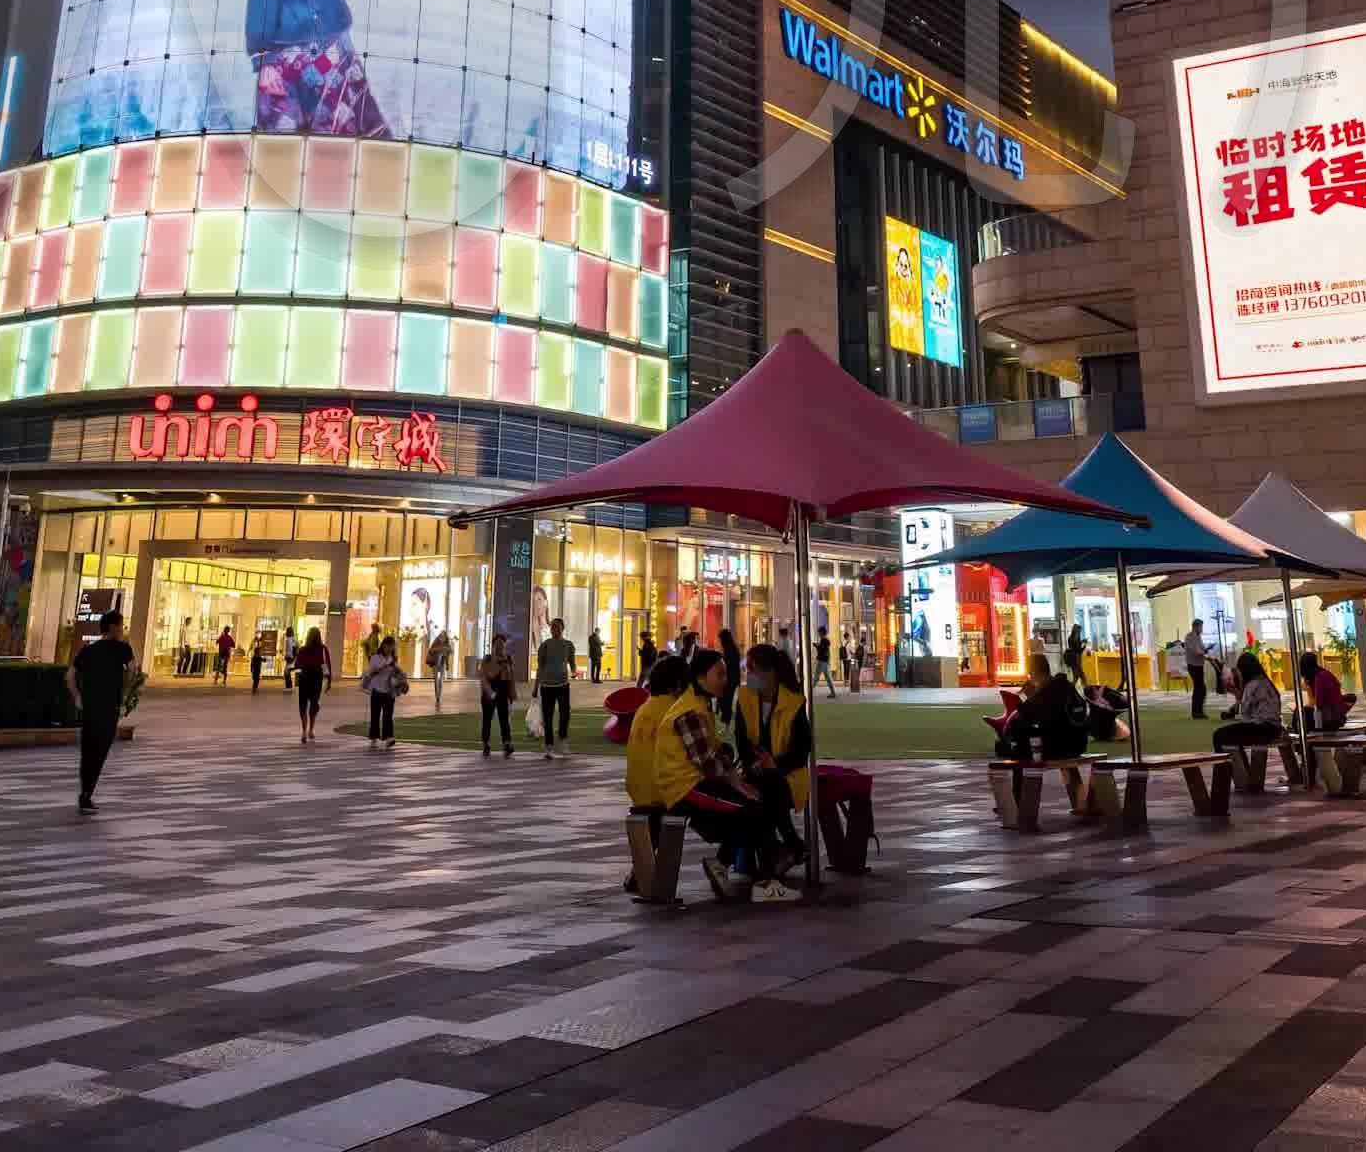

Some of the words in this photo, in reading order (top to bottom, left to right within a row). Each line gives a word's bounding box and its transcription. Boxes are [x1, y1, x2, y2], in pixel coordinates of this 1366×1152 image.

[780, 7, 905, 120] Walmart
[944, 103, 1026, 182] 沃尔玛
[1215, 118, 1366, 166] 临时场地
